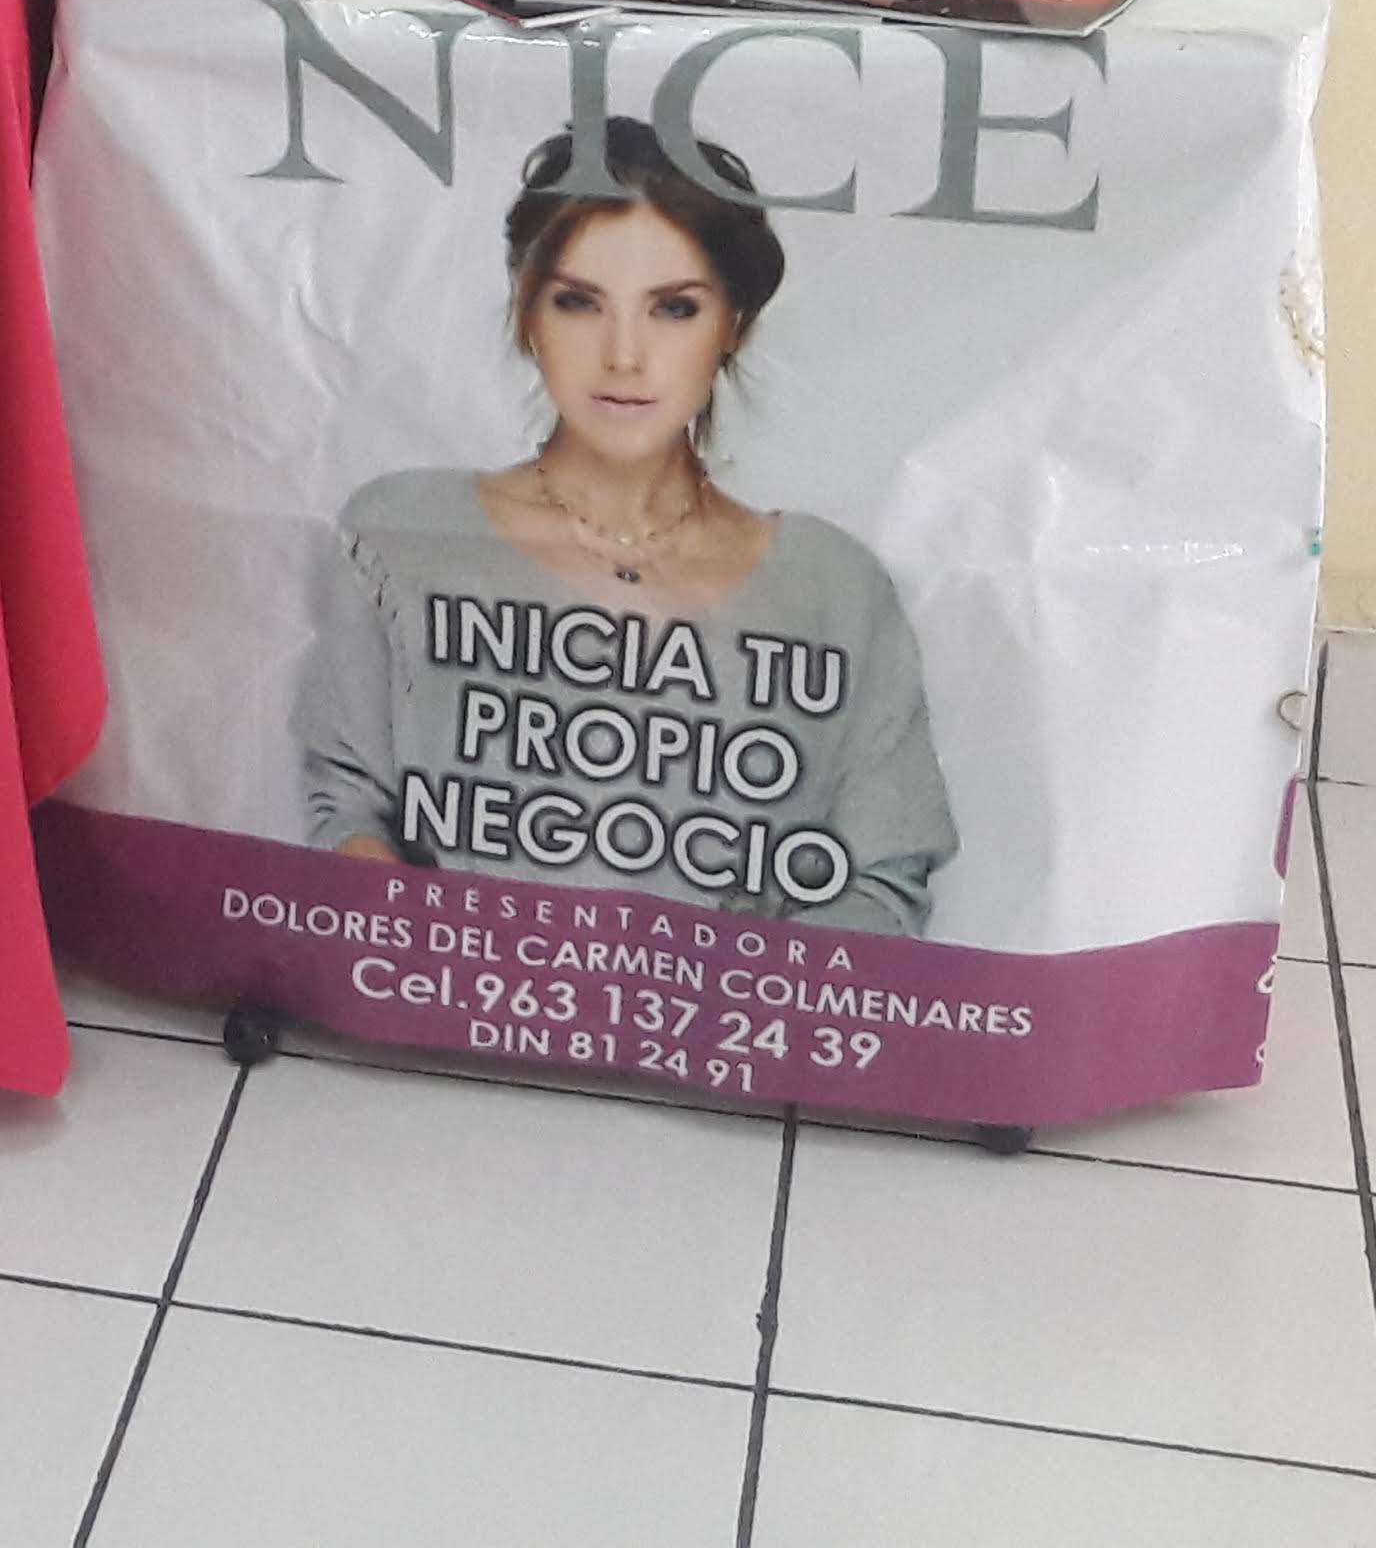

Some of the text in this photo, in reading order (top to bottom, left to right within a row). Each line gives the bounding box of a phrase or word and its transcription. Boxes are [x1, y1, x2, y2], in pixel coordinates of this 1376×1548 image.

[430, 596, 844, 716] INICIA TU
[460, 687, 801, 802] PROPIO
[401, 773, 851, 904] NEGOCIO
[222, 888, 1034, 1038] DOLORES DEL CARMEN COLMENARES
[469, 1018, 754, 1093] DIN 81 24 91
[602, 983, 698, 1039] 137
[717, 1010, 791, 1060] 24
[809, 1027, 883, 1070] 39
